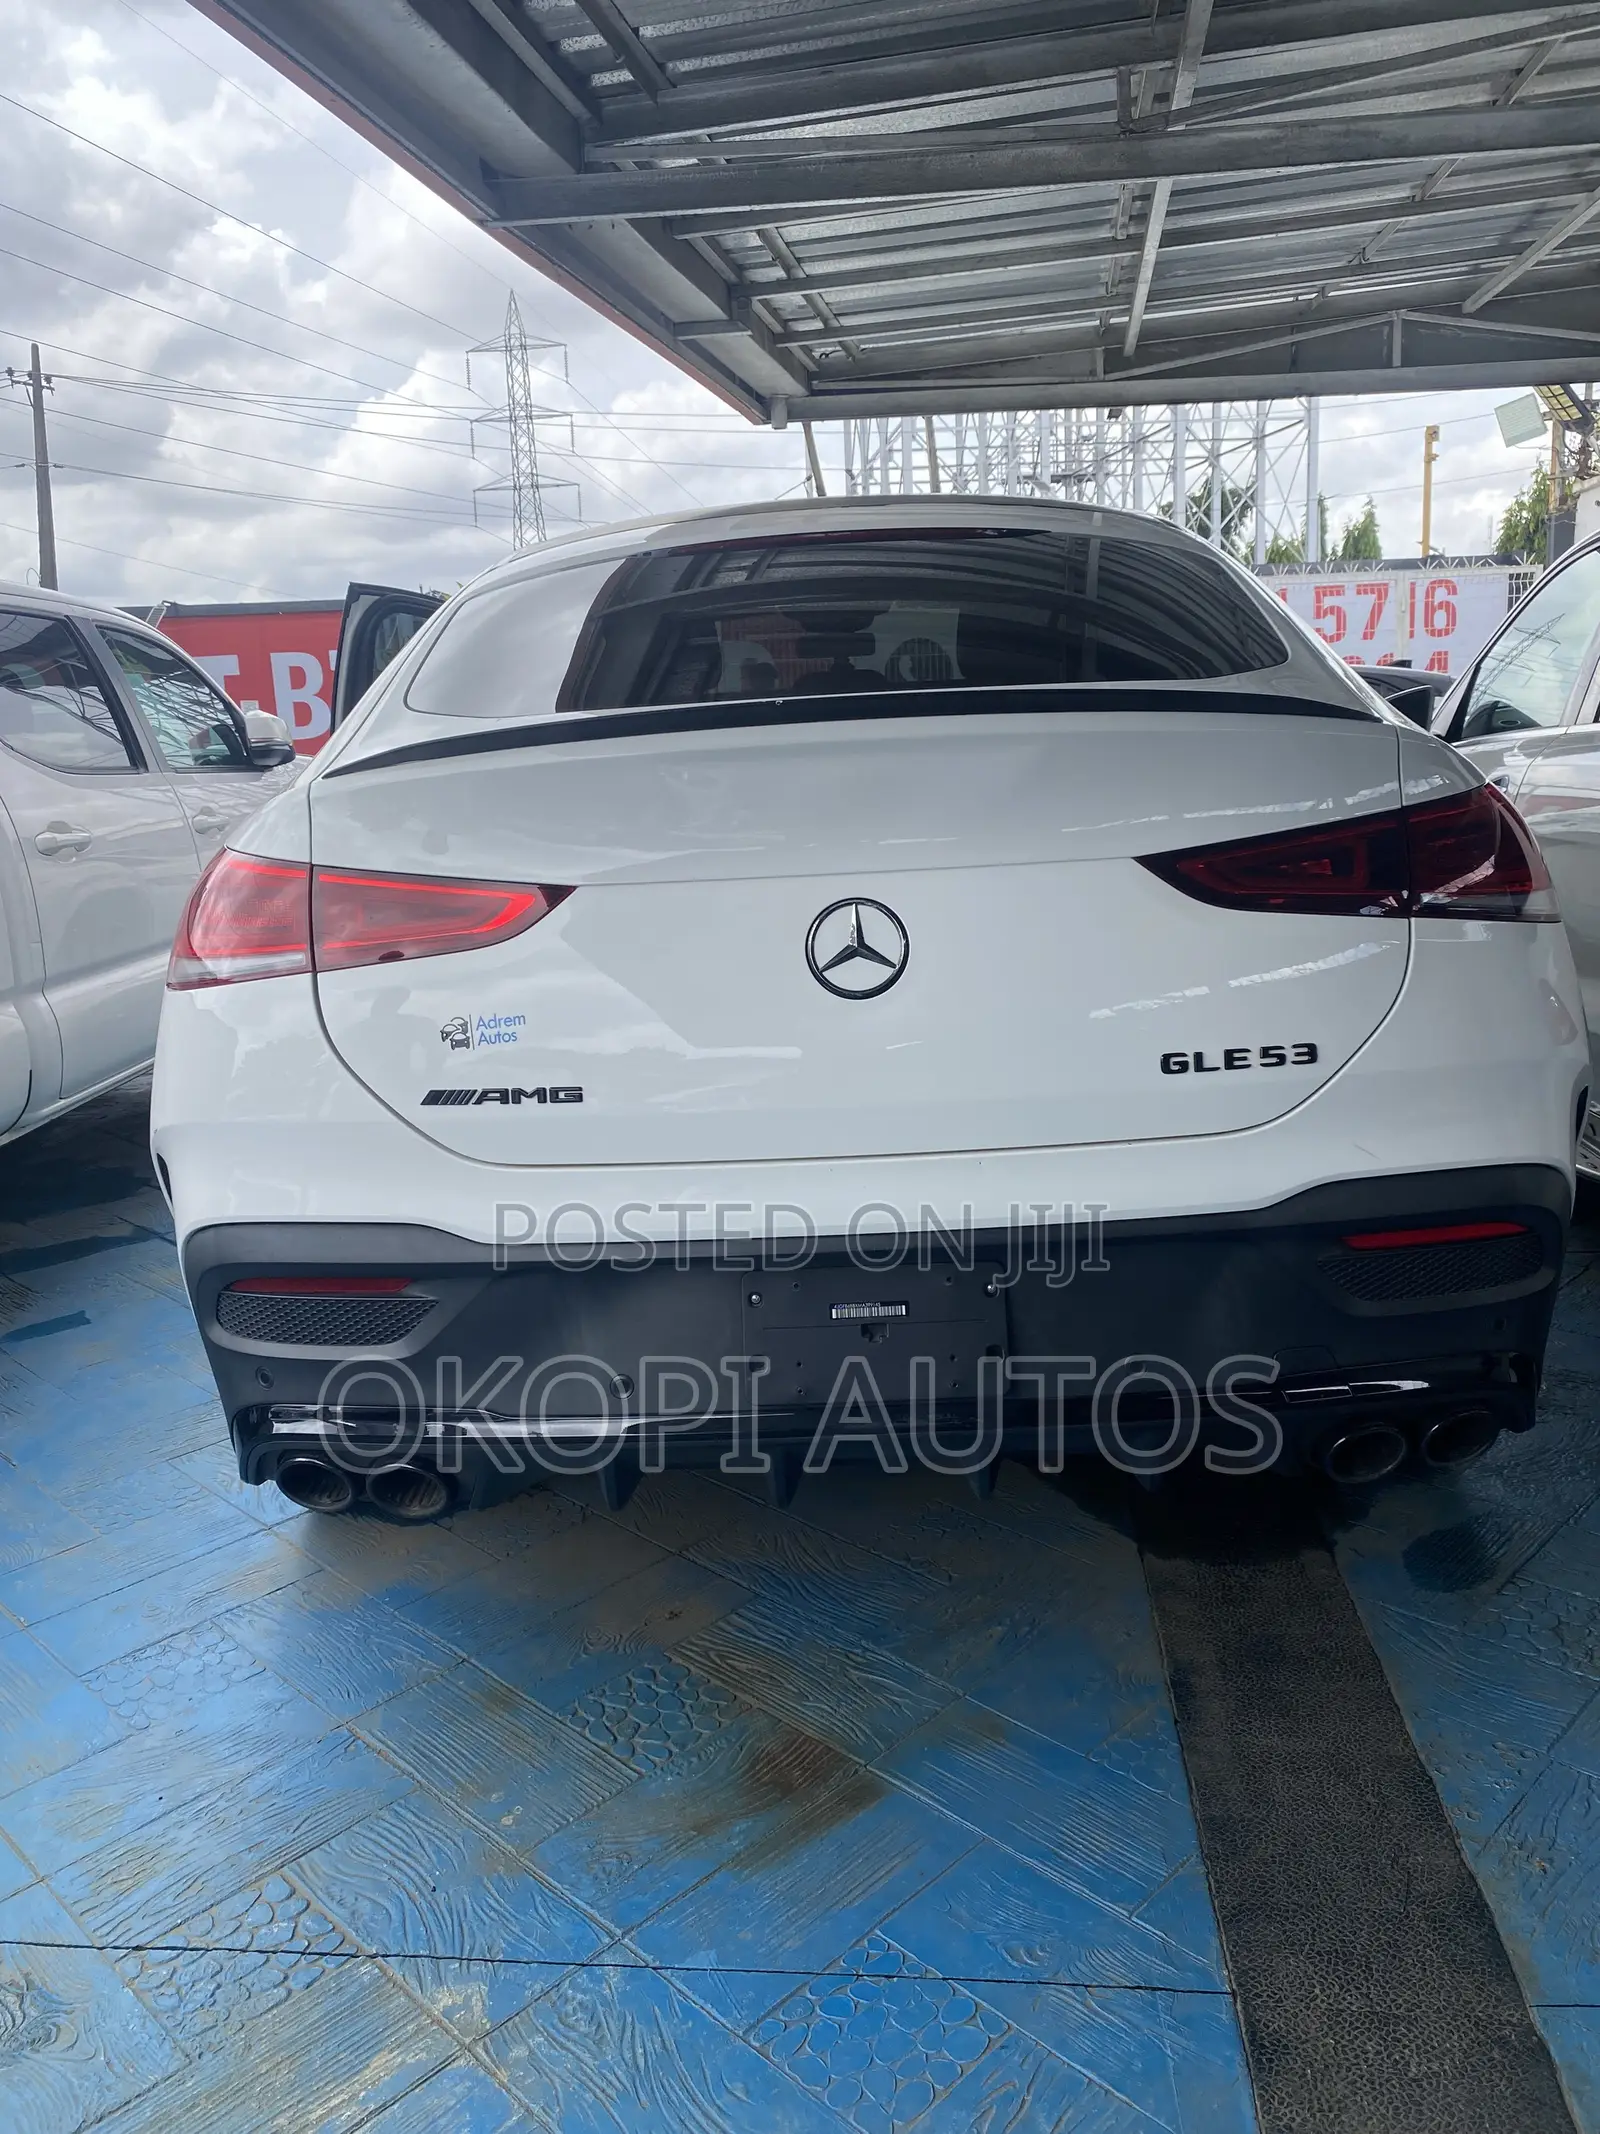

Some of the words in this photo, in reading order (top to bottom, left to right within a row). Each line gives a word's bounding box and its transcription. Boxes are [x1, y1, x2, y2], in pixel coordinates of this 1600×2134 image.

[476, 1013, 526, 1031] Adrem
[477, 1030, 518, 1046] Autos
[471, 1086, 584, 1105] AMG
